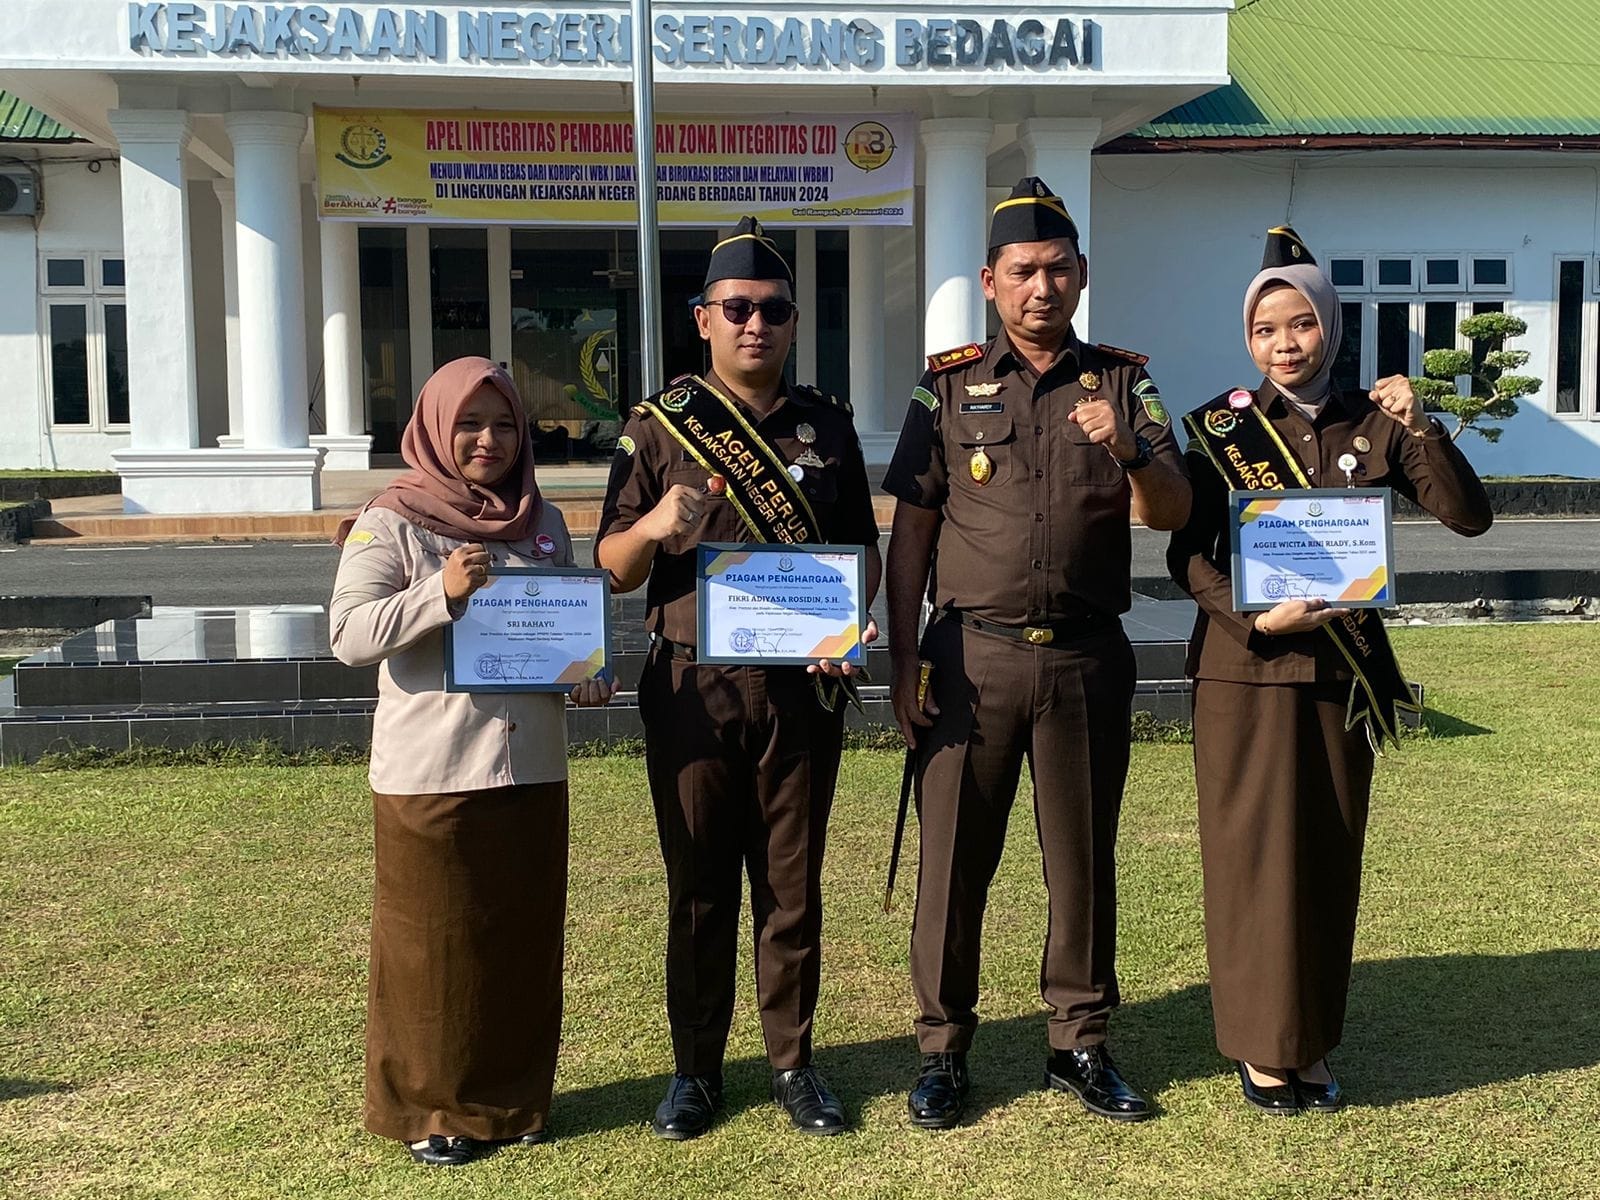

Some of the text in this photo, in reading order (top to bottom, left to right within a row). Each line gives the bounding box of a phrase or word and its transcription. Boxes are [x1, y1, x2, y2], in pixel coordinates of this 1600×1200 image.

[129, 3, 1101, 69] KEJAKSAAN NEGERI SERDANG BEDAGAI
[426, 121, 837, 155] APEL INTEGRITAS PEMBANGAN ZONA INTEGRITAS (ZI)
[430, 163, 461, 179] MENUJU
[463, 163, 499, 180] WILAYAH
[500, 164, 526, 180] BEBAS
[527, 164, 547, 180] DARI
[548, 165, 583, 181] KORUPSI
[615, 165, 632, 181] DAN
[668, 166, 712, 181] BIROKRASI
[713, 166, 740, 182] BERSIH
[742, 166, 758, 182] DAN
[760, 166, 797, 182] MELAYANI
[435, 183, 448, 198] DI
[451, 183, 527, 199] LINGKUNGAN
[529, 185, 596, 200] KEJAKSAAN
[599, 186, 637, 201] NEGER
[699, 187, 756, 201] BERDAGAI
[759, 187, 797, 202] TAHUN
[799, 187, 829, 202] 2024
[324, 200, 379, 208] BerAKHLAK
[1224, 444, 1264, 491] KEJAKS
[684, 415, 747, 480] KEJAKSAAN
[742, 478, 777, 523] NEGERI
[773, 522, 796, 545] SER
[716, 430, 765, 478] AGEN
[761, 479, 808, 543] PERUB
[1258, 518, 1370, 529] PIAGAM PENGHARGAAN
[1253, 541, 1277, 549] AGGIE
[1352, 539, 1376, 547] S.Kom
[726, 574, 842, 583] PIAGAM PENGHARGAAN
[472, 599, 588, 608] PIAGAM PENGHARGAAN
[751, 595, 787, 603] ADIYASA
[1340, 615, 1372, 657] EDAGAI
